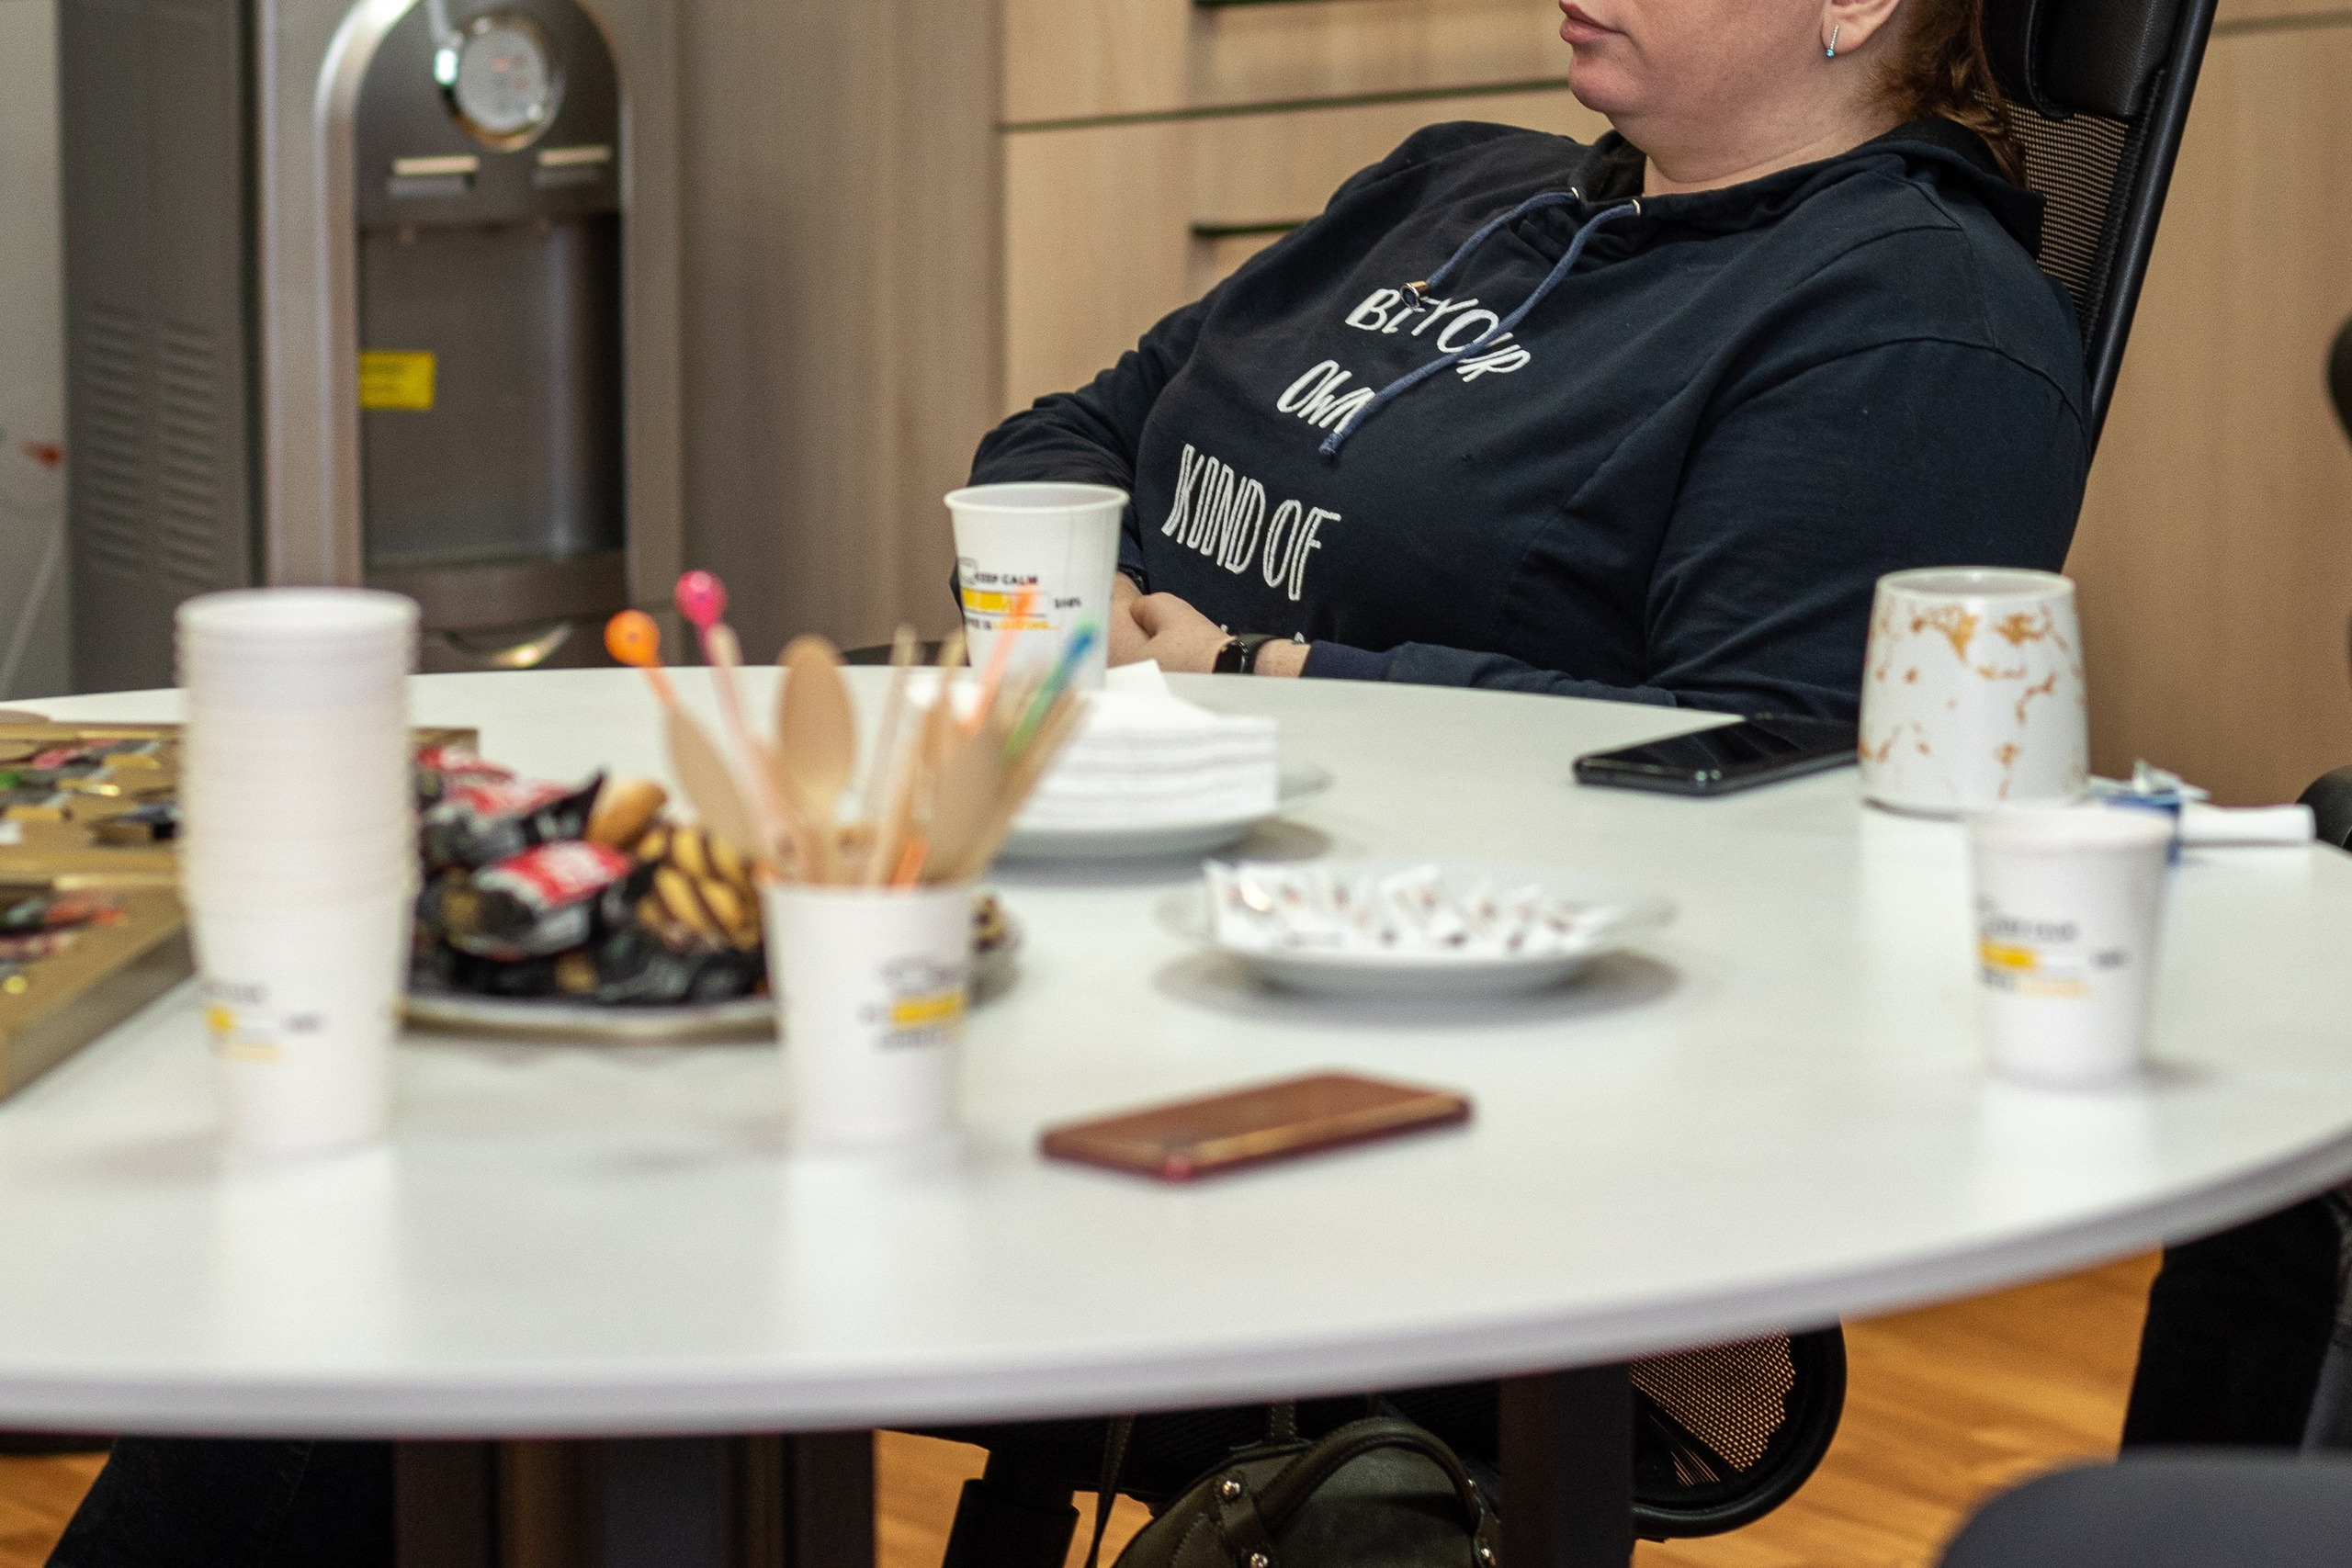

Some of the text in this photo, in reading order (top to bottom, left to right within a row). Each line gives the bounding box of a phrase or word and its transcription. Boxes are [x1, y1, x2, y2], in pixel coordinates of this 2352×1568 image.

[1345, 288, 1532, 382] BE YOUR
[1276, 359, 1376, 434] OWN
[1160, 443, 1342, 601] KIND OF
